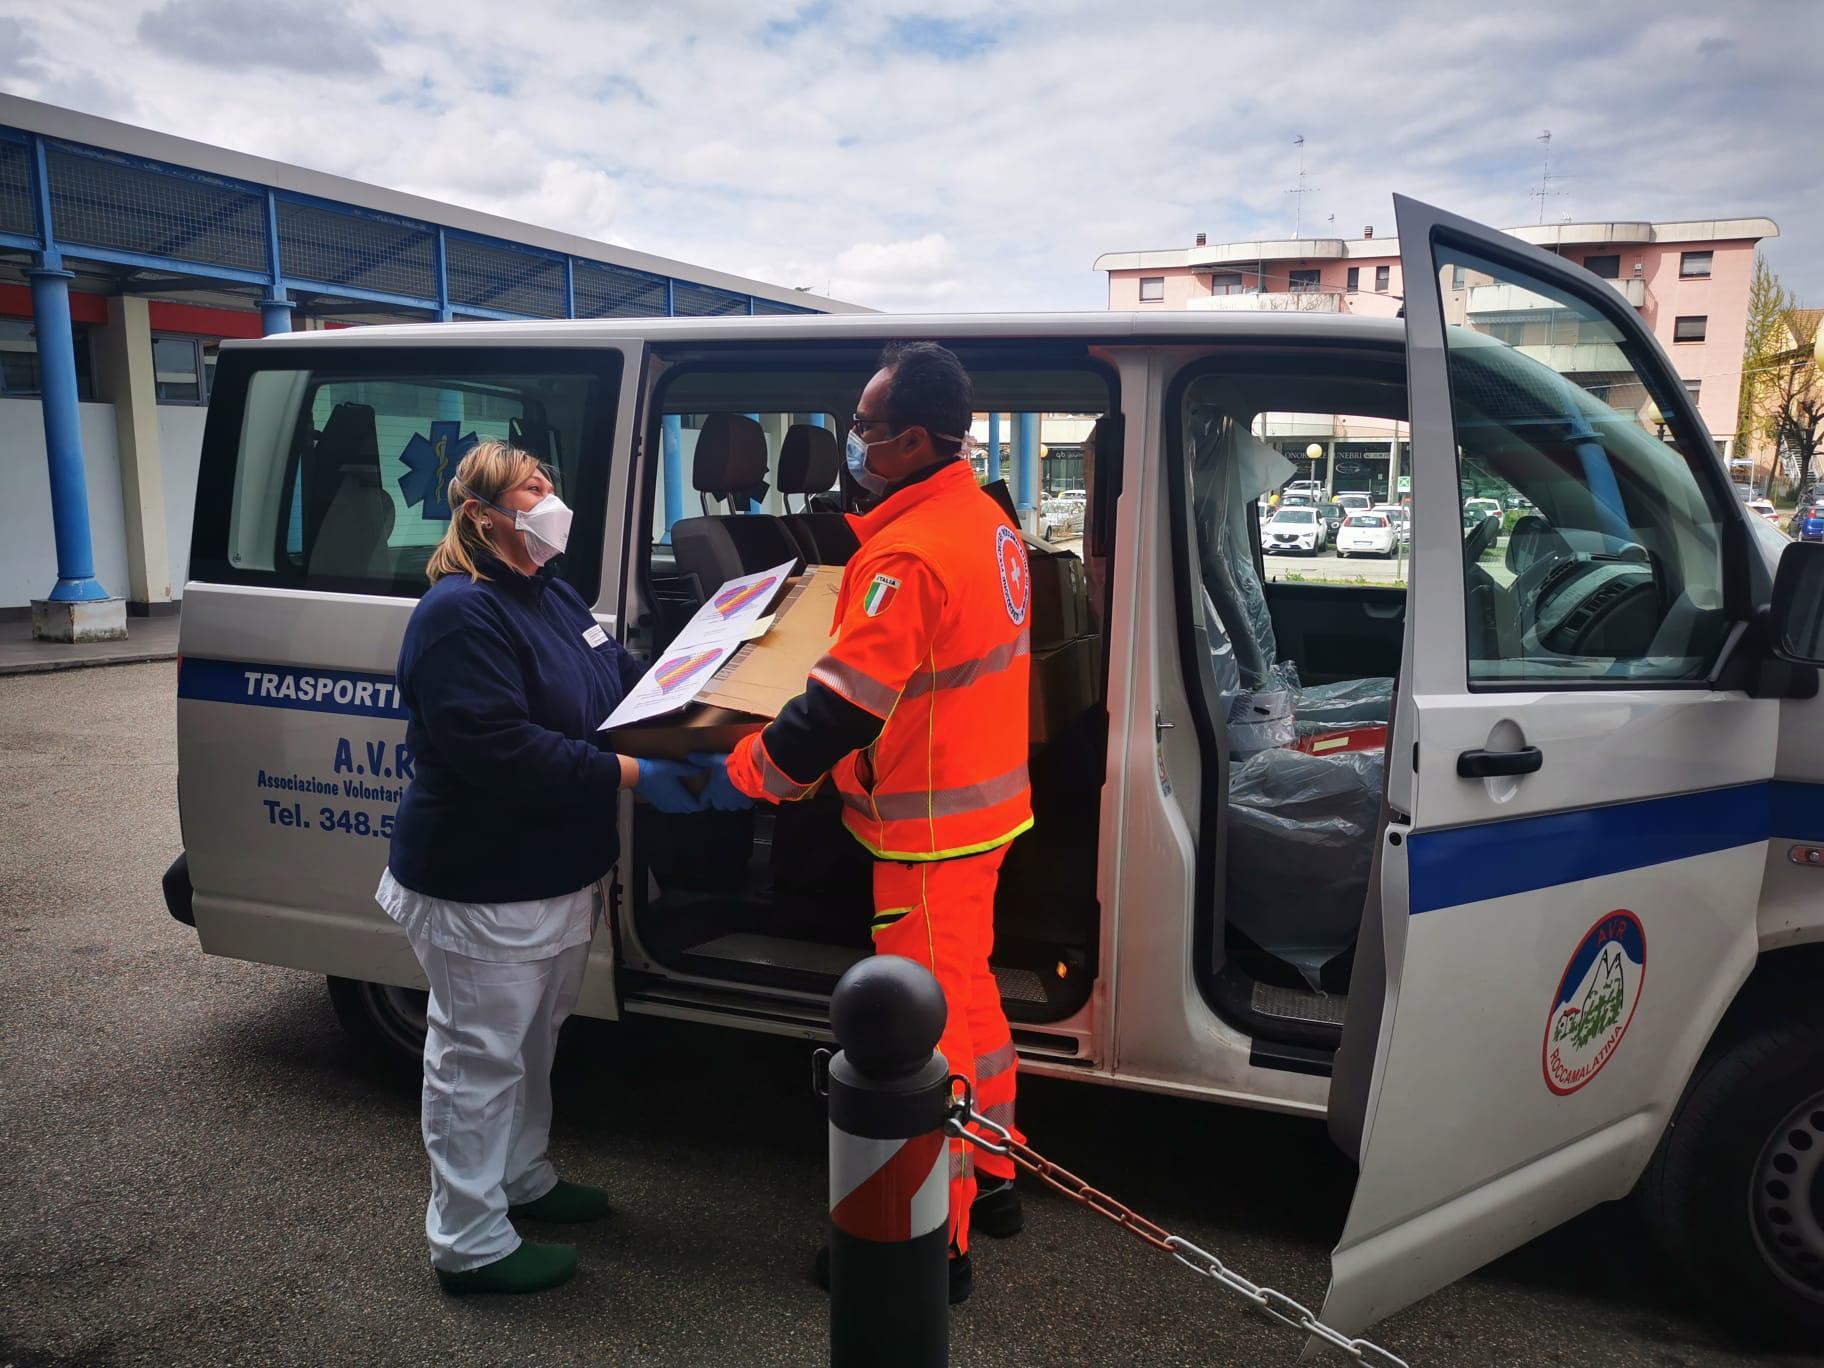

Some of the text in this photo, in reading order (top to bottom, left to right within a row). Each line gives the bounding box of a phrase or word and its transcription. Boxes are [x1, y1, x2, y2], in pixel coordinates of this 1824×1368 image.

[876, 575, 896, 587] ITALIA
[244, 671, 402, 709] TRASPORTI
[257, 770, 403, 804] Associazione Volontari
[263, 799, 310, 829] Tel.
[1596, 921, 1628, 948] AVR
[1550, 1026, 1623, 1084] ROCCAMALATINA
